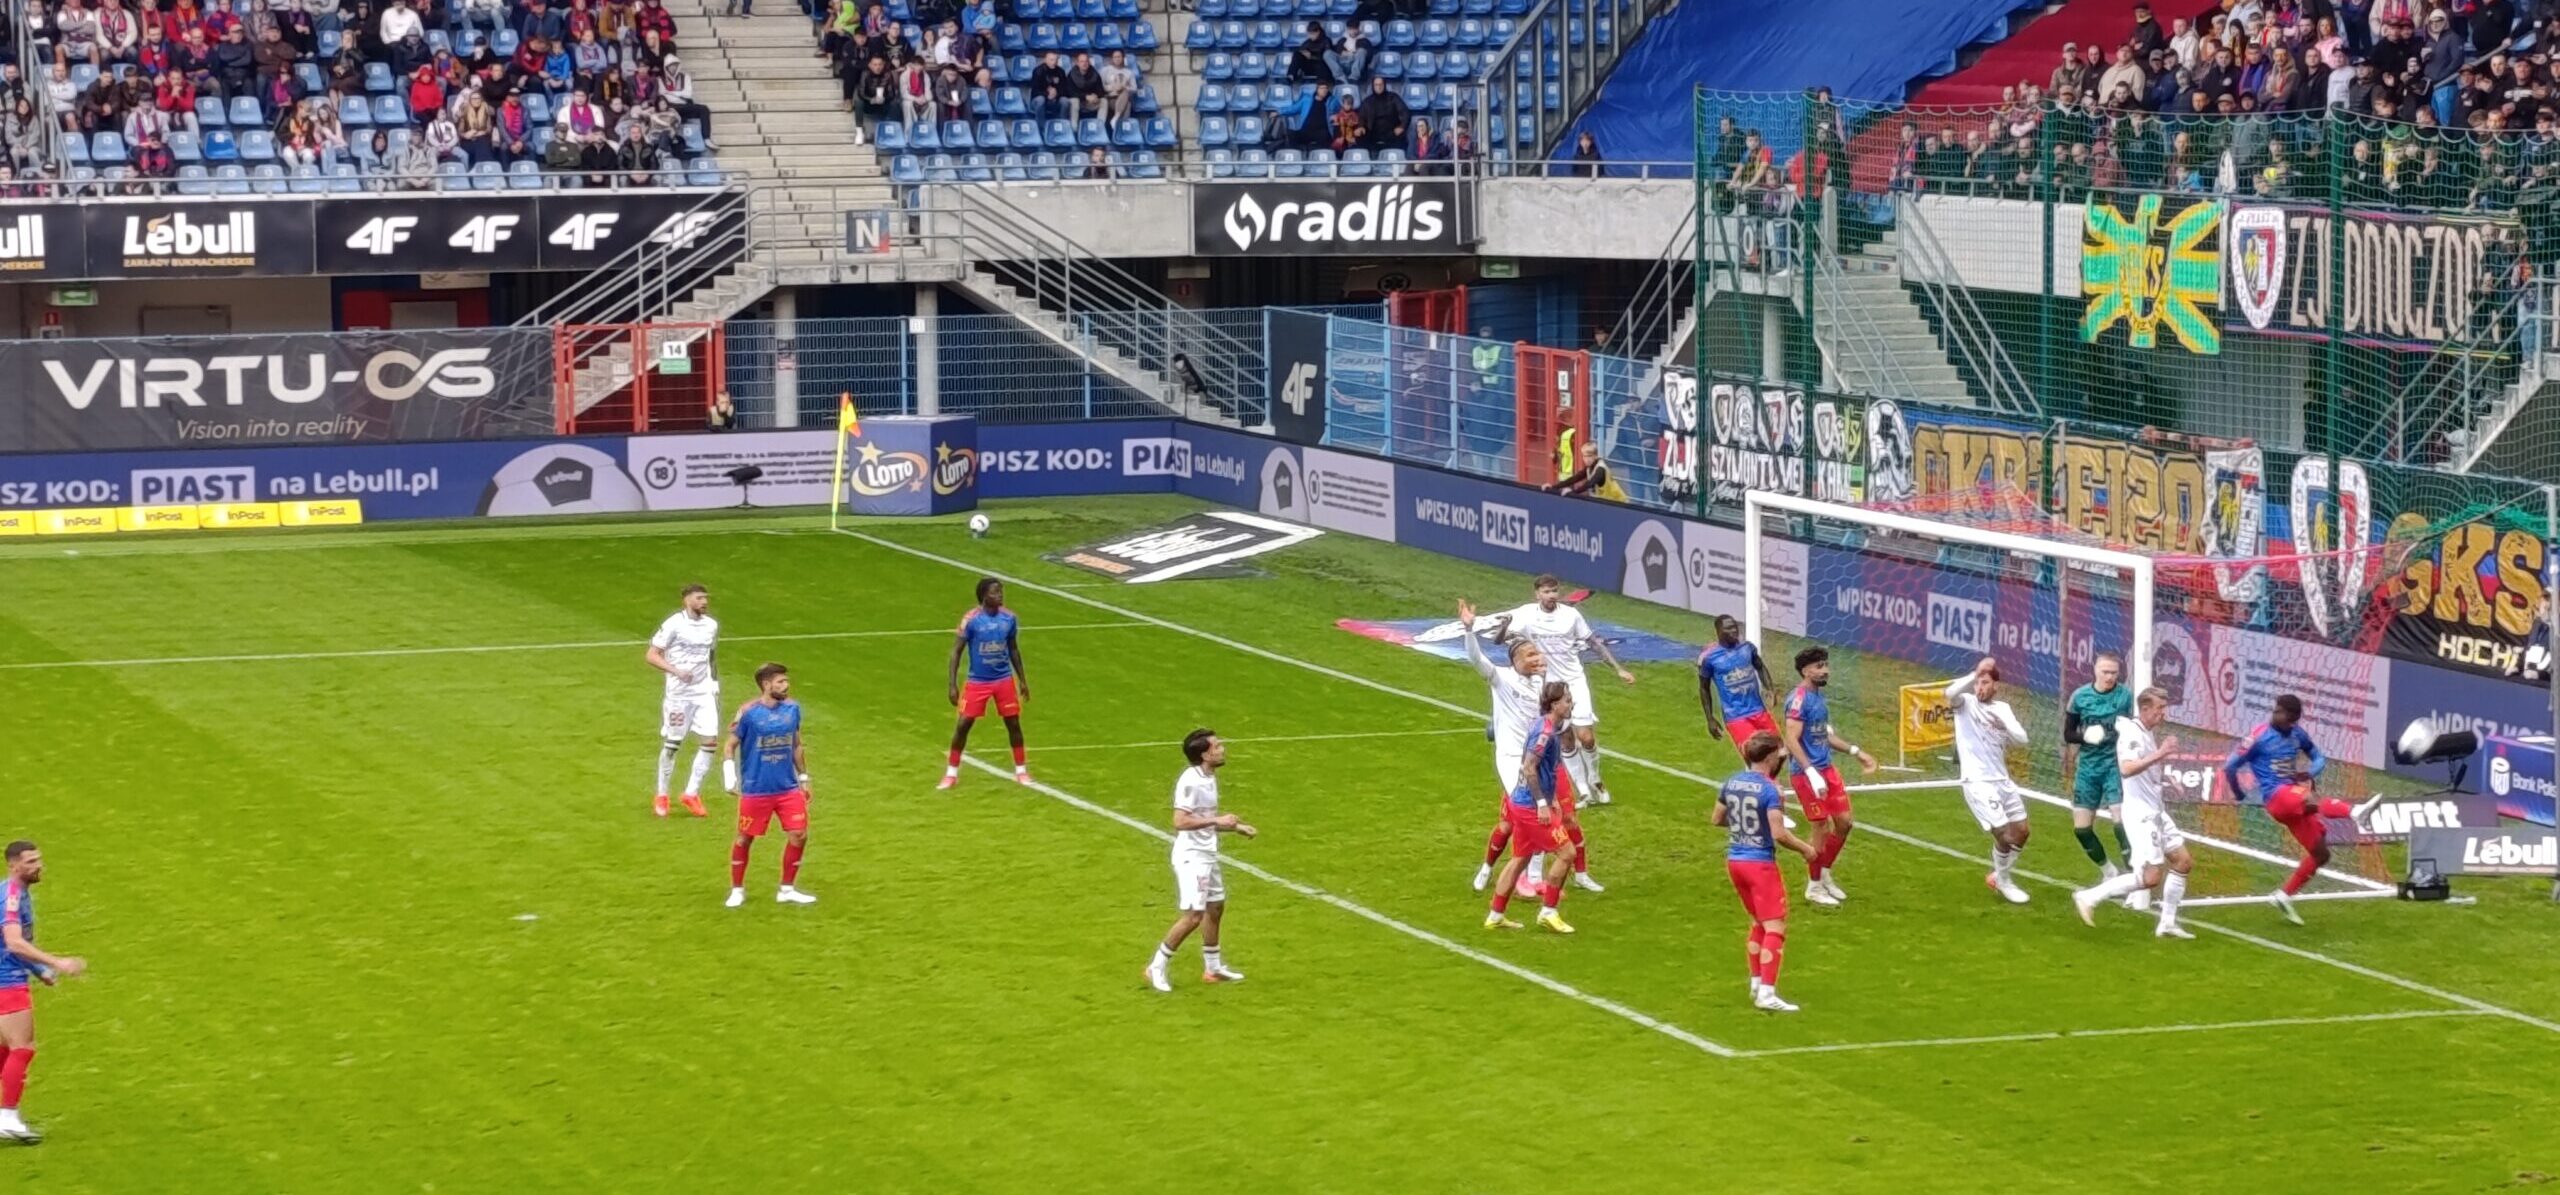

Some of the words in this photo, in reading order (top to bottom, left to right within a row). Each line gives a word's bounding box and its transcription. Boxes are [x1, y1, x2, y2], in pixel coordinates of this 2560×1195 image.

[549, 213, 619, 250] 4F
[1269, 184, 1444, 241] radiis
[123, 211, 255, 255] Lebull
[346, 216, 418, 254] 4F
[449, 215, 520, 253] 4F
[856, 218, 880, 248] N
[668, 345, 682, 356] 14
[42, 348, 495, 410] VIRTU-OS
[1281, 361, 1317, 415] 4F
[176, 419, 240, 440] Vision
[247, 418, 290, 437] into
[296, 414, 368, 440] reality
[867, 461, 914, 487] LOTTO
[941, 457, 969, 486] LOTTO
[976, 451, 1040, 473] PISZ
[1046, 449, 1113, 471] KOD:
[1133, 445, 1190, 474] PIAST
[1194, 454, 1206, 472] na
[1207, 456, 1245, 485] Lebull.pl
[46, 480, 120, 503] KOD:
[141, 474, 248, 502] PIAST
[270, 474, 306, 495] na
[313, 466, 439, 497] Lebull.pl
[1415, 496, 1451, 524] WPISZ
[1451, 504, 1479, 532] KOD:
[1486, 504, 1526, 546] PIAST
[1534, 523, 1549, 545] na
[1551, 523, 1603, 558] Lebull.pl
[1836, 587, 1884, 620] WPISZ
[1884, 596, 1921, 629] KOD:
[1931, 599, 1988, 649] PIAST
[1998, 623, 2017, 648] na
[2022, 624, 2095, 663] Lebul.pl
[2512, 772, 2536, 793] Bank
[1725, 794, 1760, 835] 36
[2463, 836, 2558, 866] Lebull
